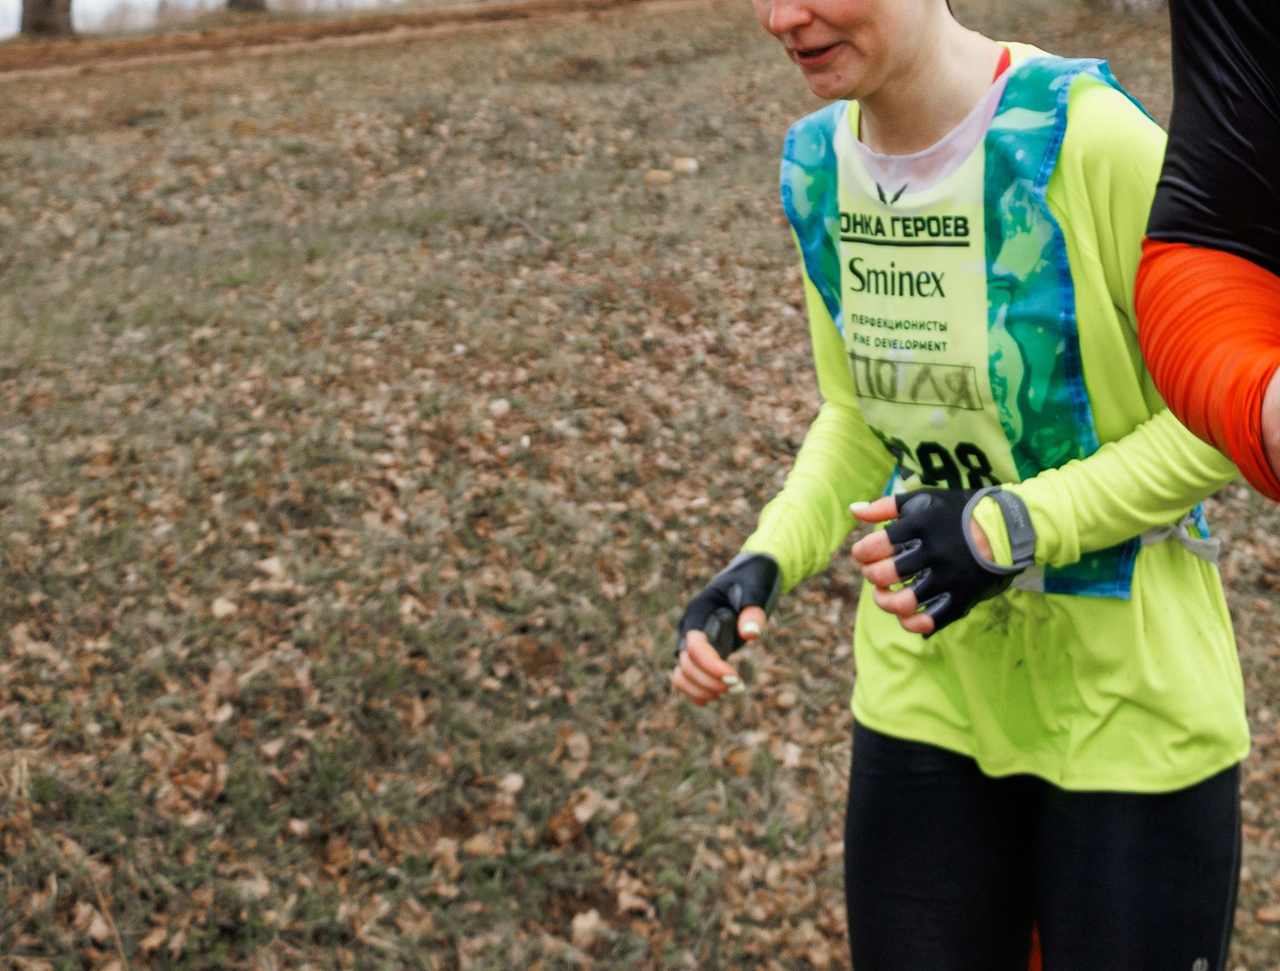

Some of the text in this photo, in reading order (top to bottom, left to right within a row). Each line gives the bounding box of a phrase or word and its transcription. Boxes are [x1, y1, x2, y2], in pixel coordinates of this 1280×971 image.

[840, 211, 970, 238] ОНКА ГЕРОЕВ
[848, 257, 946, 298] Sminex
[851, 313, 948, 332] ПЕРФЕКЦИОНИСТЫ
[853, 332, 948, 352] FINE DEVELOPMENT
